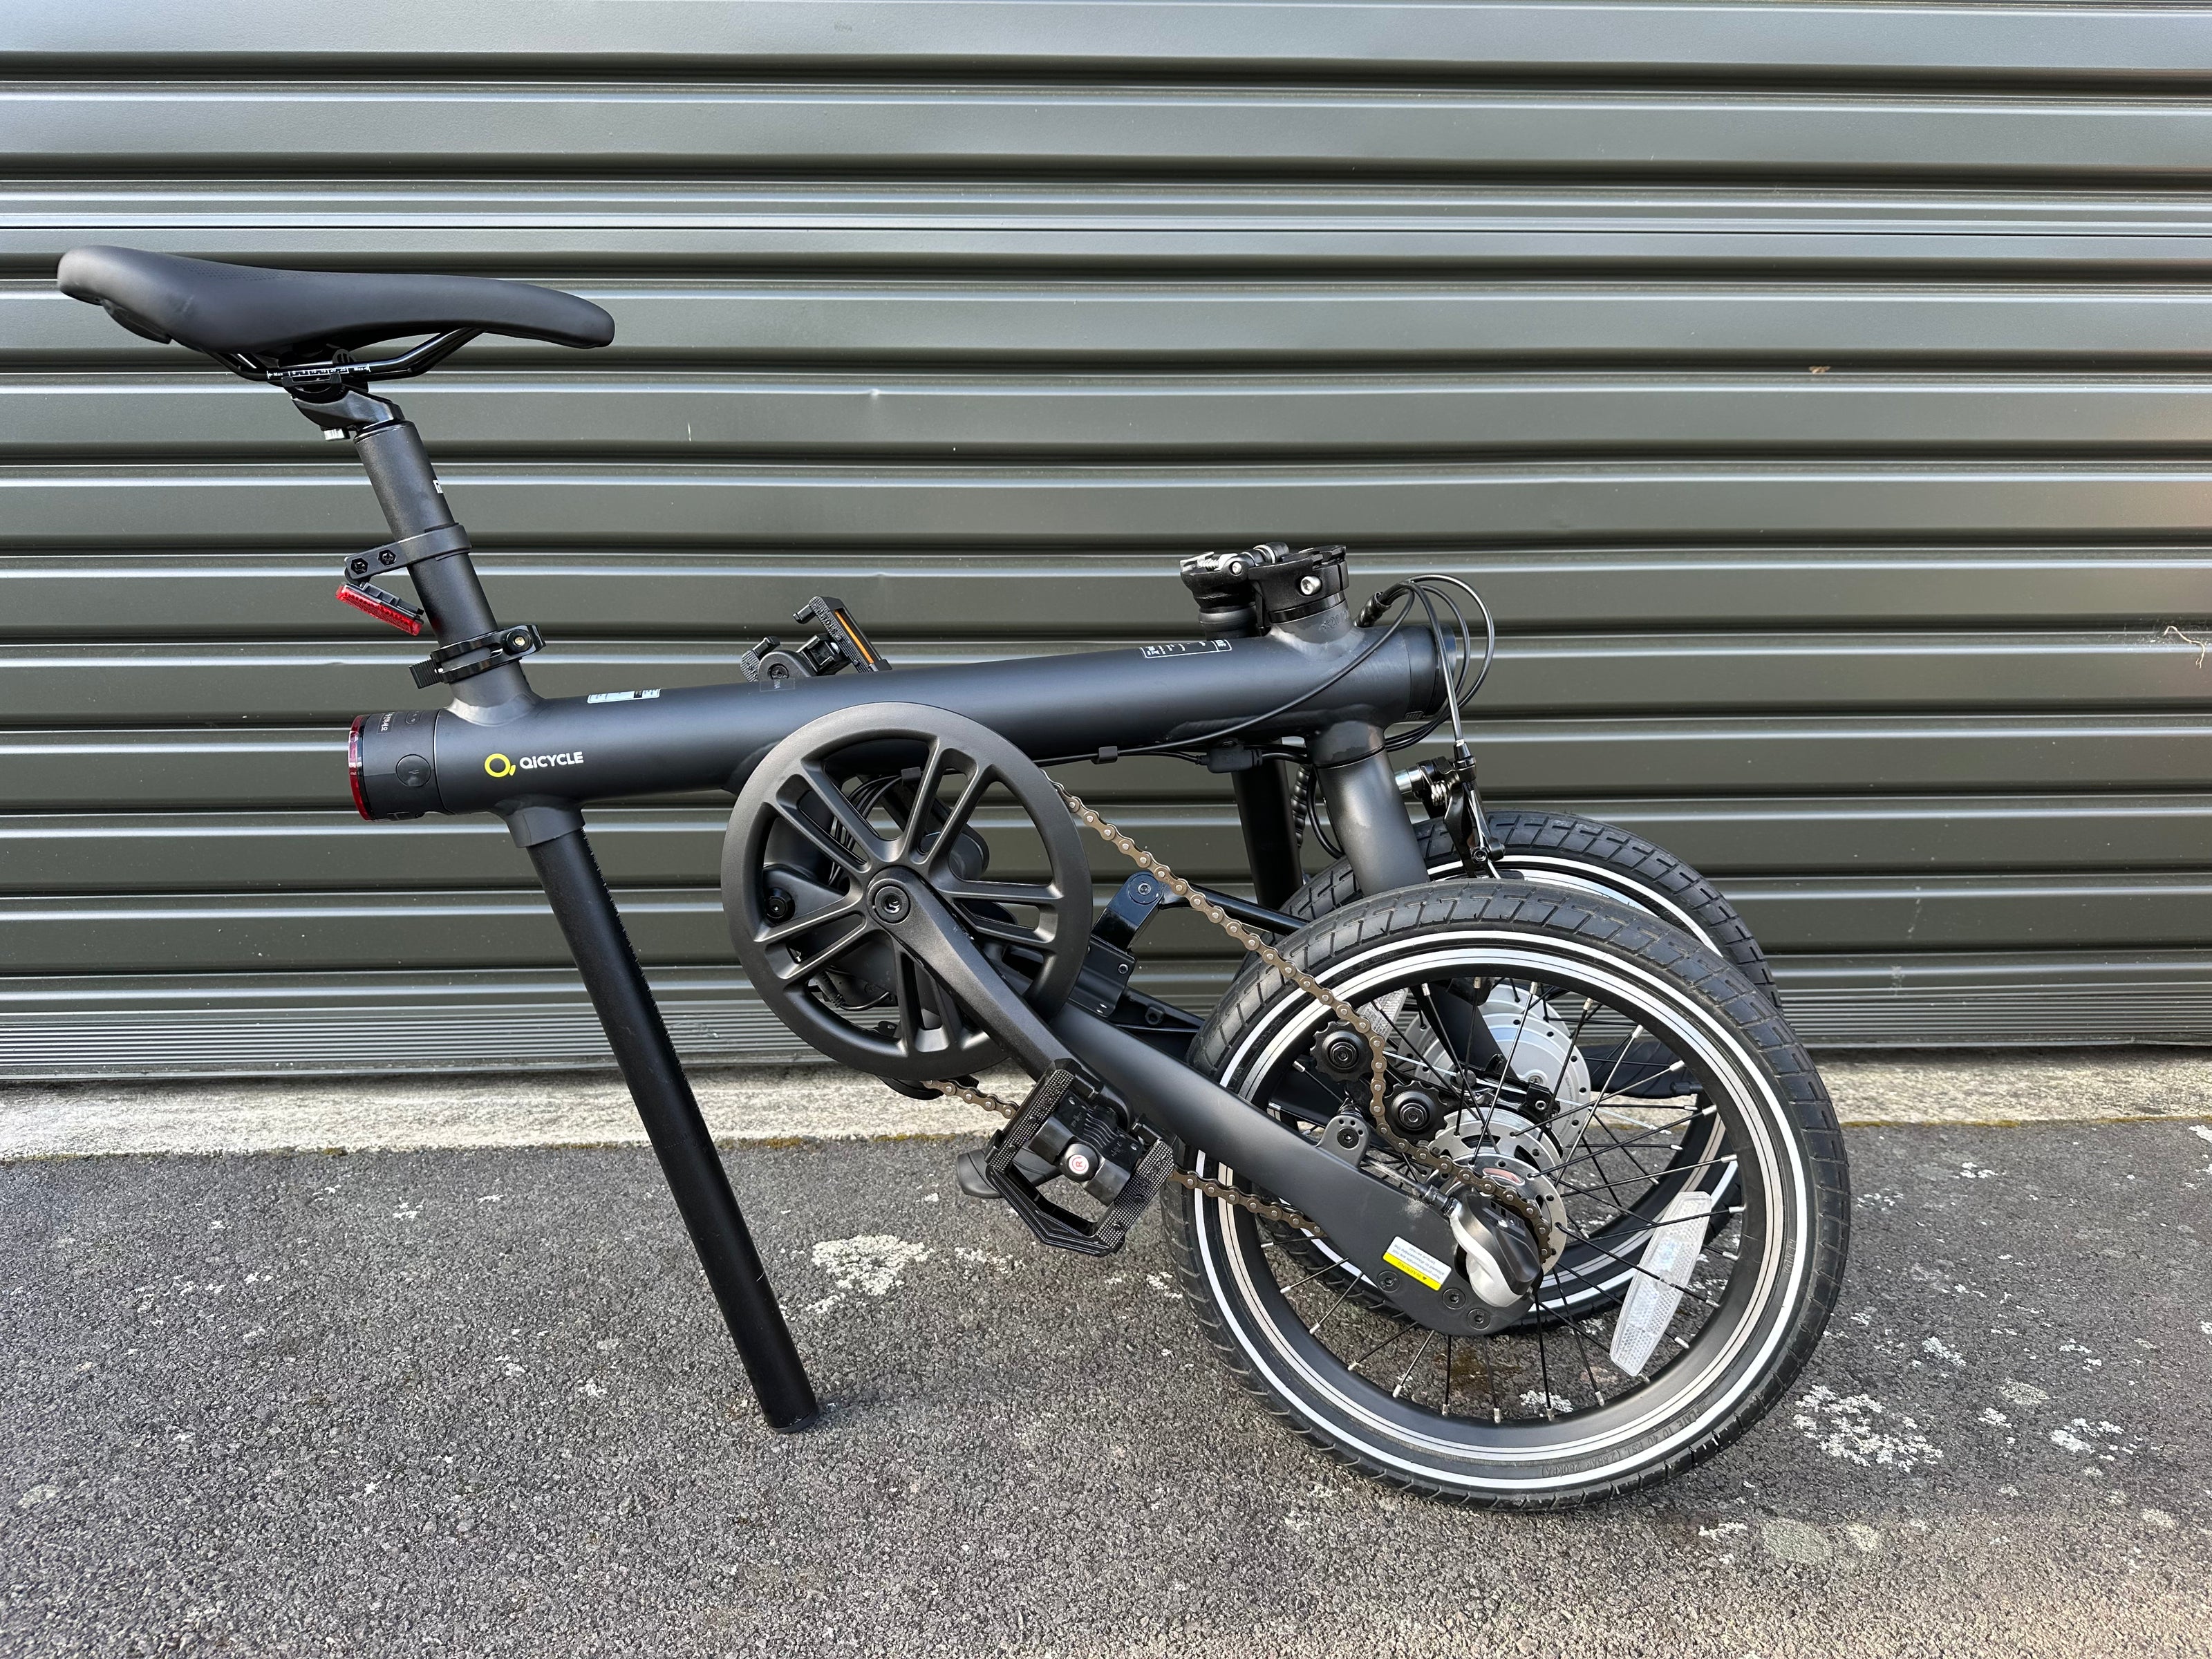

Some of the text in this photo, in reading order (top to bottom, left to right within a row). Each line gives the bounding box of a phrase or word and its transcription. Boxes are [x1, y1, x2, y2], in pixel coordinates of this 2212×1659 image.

[1397, 1262, 1421, 1277] WARNING
[1676, 1401, 1707, 1430] INFLATE
[1662, 1427, 1674, 1438] TO
[1648, 1434, 1660, 1445] 40
